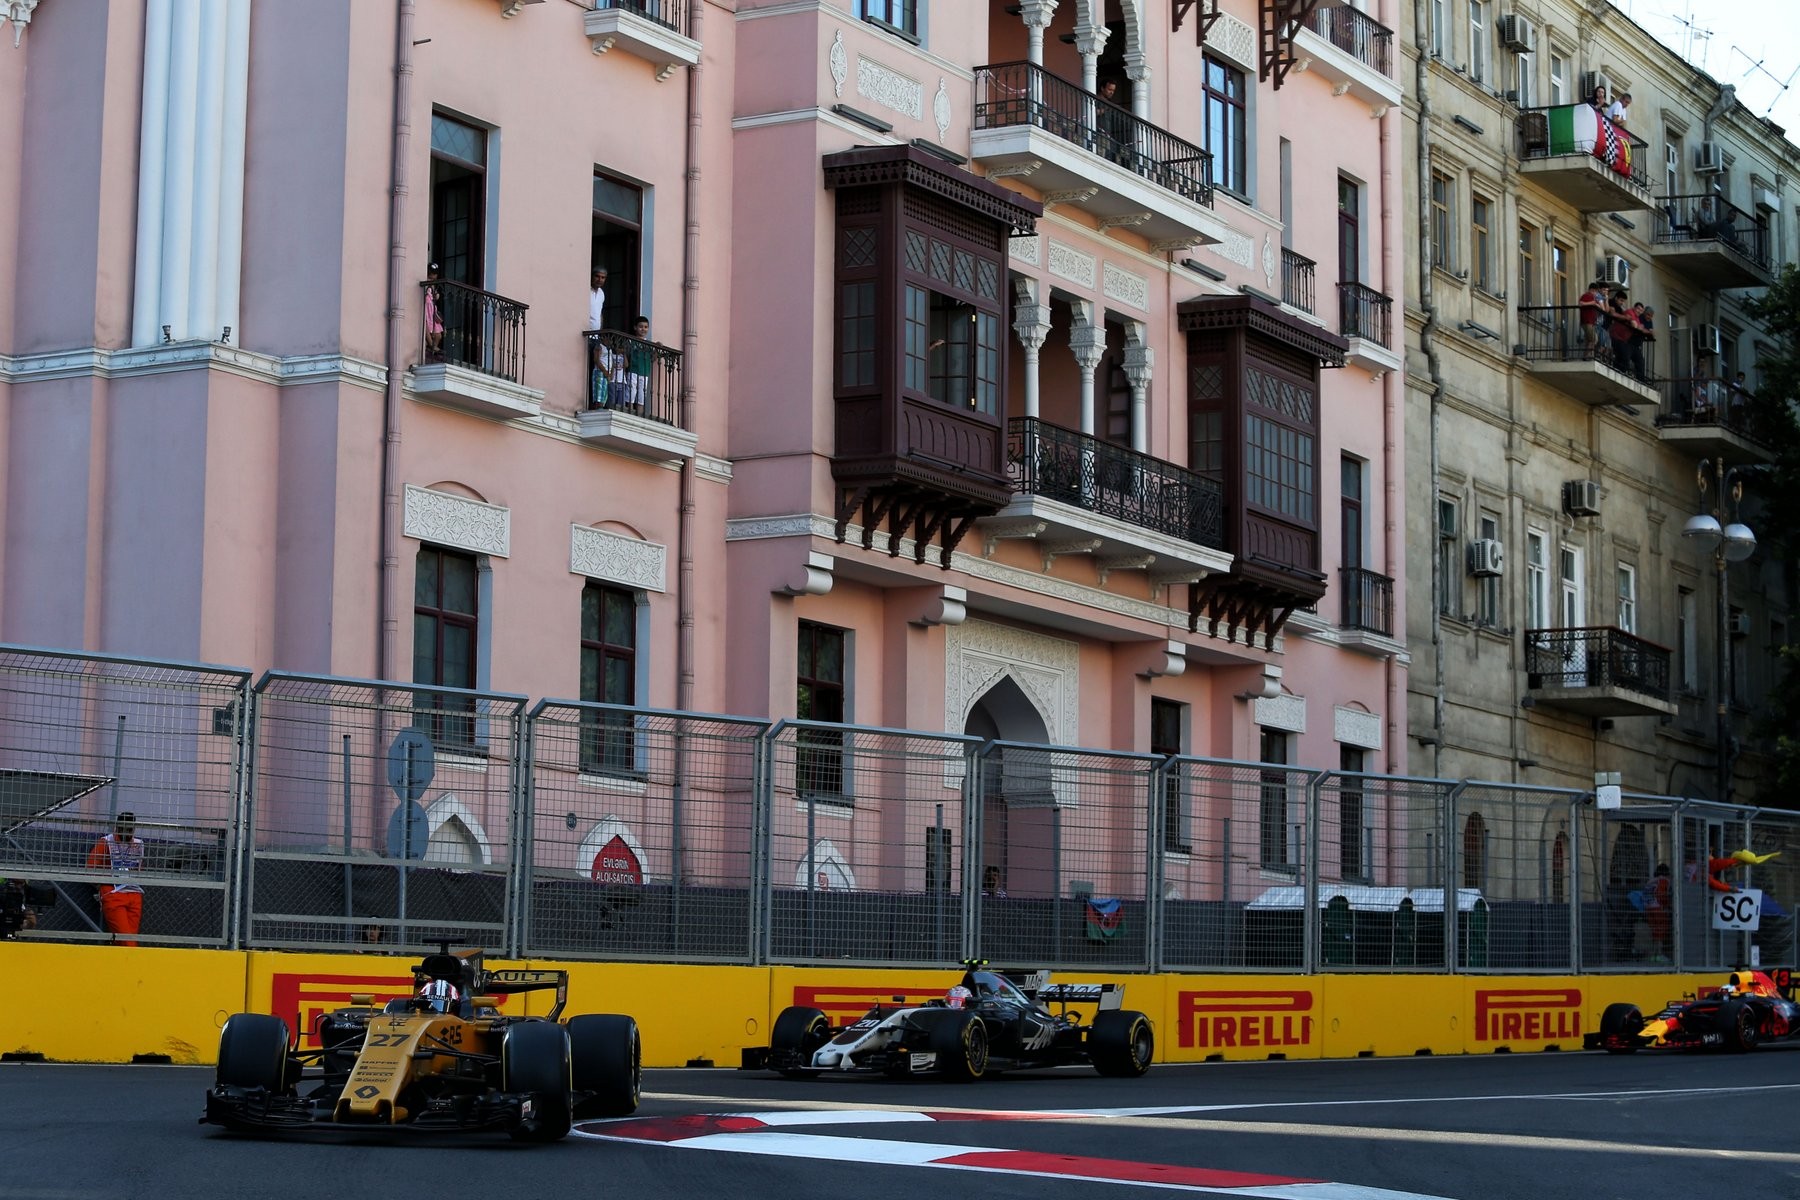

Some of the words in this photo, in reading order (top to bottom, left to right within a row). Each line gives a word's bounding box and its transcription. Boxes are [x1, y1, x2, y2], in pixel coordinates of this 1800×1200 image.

[1720, 896, 1754, 923] SC
[854, 1019, 880, 1028] 20
[1178, 991, 1313, 1048] PIRELLI
[1475, 989, 1582, 1041] PIRELLI
[368, 1034, 411, 1047] 27
